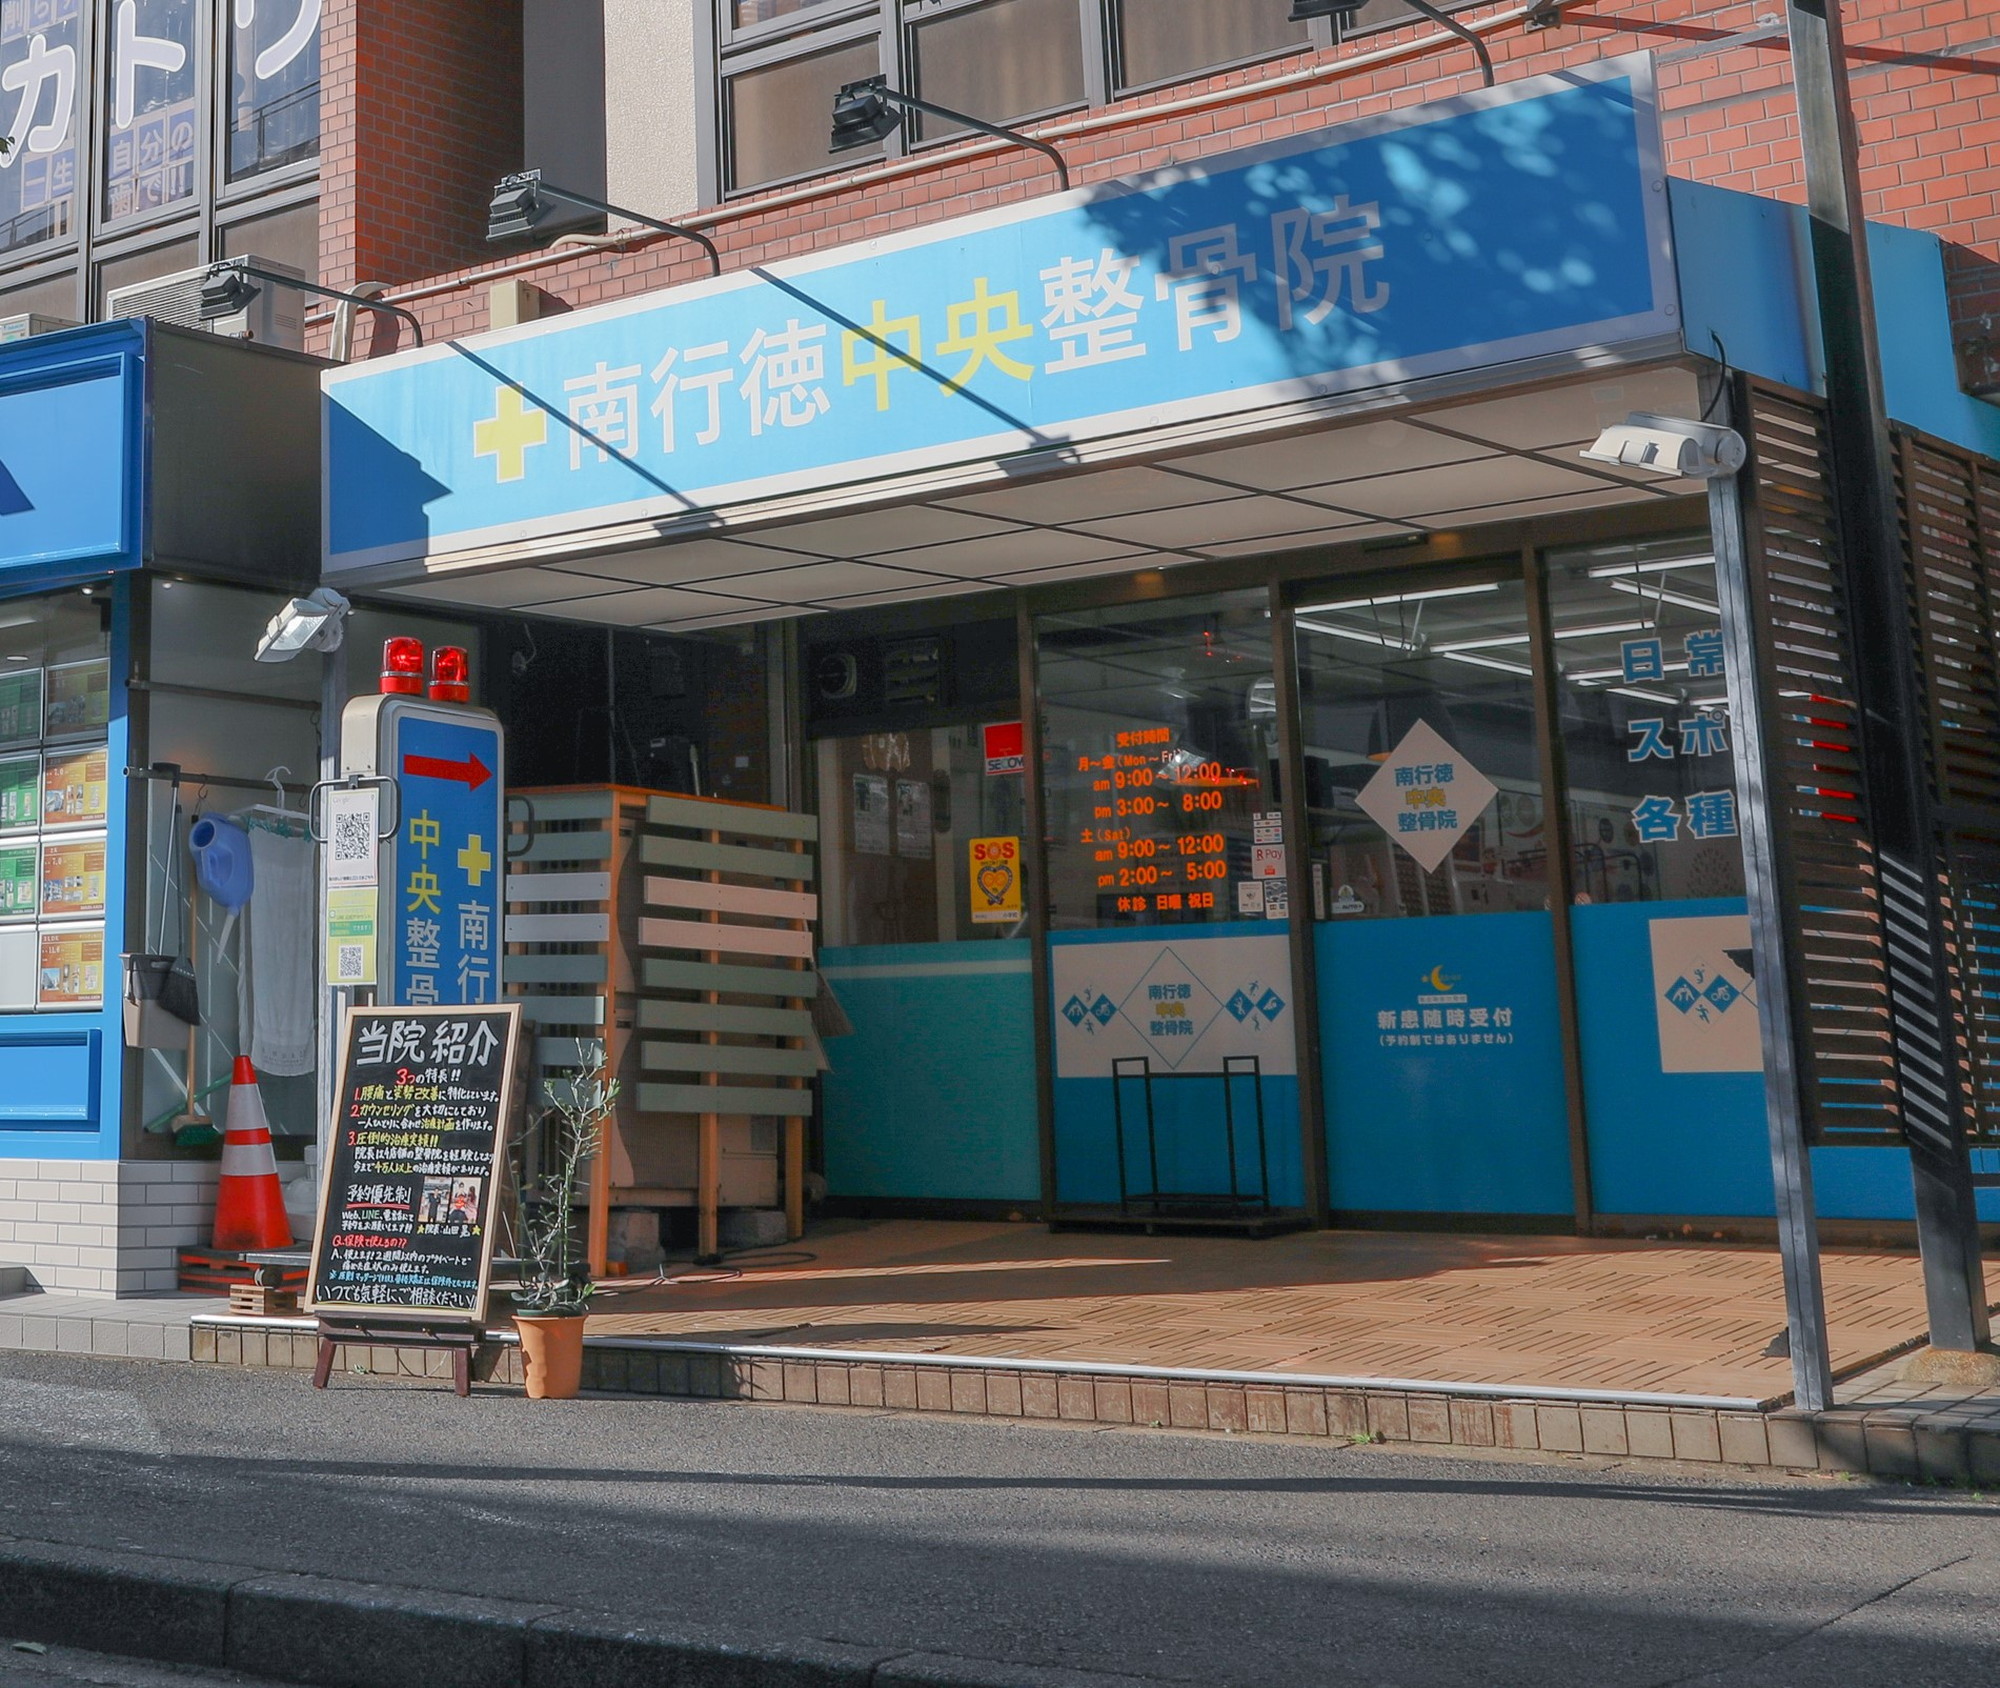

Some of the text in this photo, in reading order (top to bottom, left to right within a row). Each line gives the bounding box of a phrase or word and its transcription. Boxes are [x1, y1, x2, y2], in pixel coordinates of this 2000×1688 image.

[25, 121, 194, 190] 一生 自分の
[563, 194, 1391, 472] 南行徳中央整骨院
[1620, 628, 1725, 684] 日常
[1116, 727, 1170, 748] 受付時間
[1627, 708, 1729, 762] スポ
[1093, 780, 1110, 791] am
[1394, 763, 1454, 787] 南行徳
[1094, 806, 1112, 819] pm
[1183, 791, 1223, 812] 8:00
[1405, 787, 1447, 809] 中央
[1397, 809, 1458, 832] 整骨院
[1632, 789, 1738, 844] 各種
[974, 841, 1015, 861] SOS
[1095, 849, 1113, 862] am
[1177, 834, 1224, 855] 12:00
[1265, 848, 1283, 861] Pay
[1097, 874, 1115, 888] pm
[1186, 860, 1227, 881] 5:00
[1148, 983, 1192, 1000] 南行徳
[1155, 1001, 1187, 1019] 中央
[1377, 1006, 1513, 1031] 新患随時受付
[1150, 1019, 1194, 1037] 整骨院
